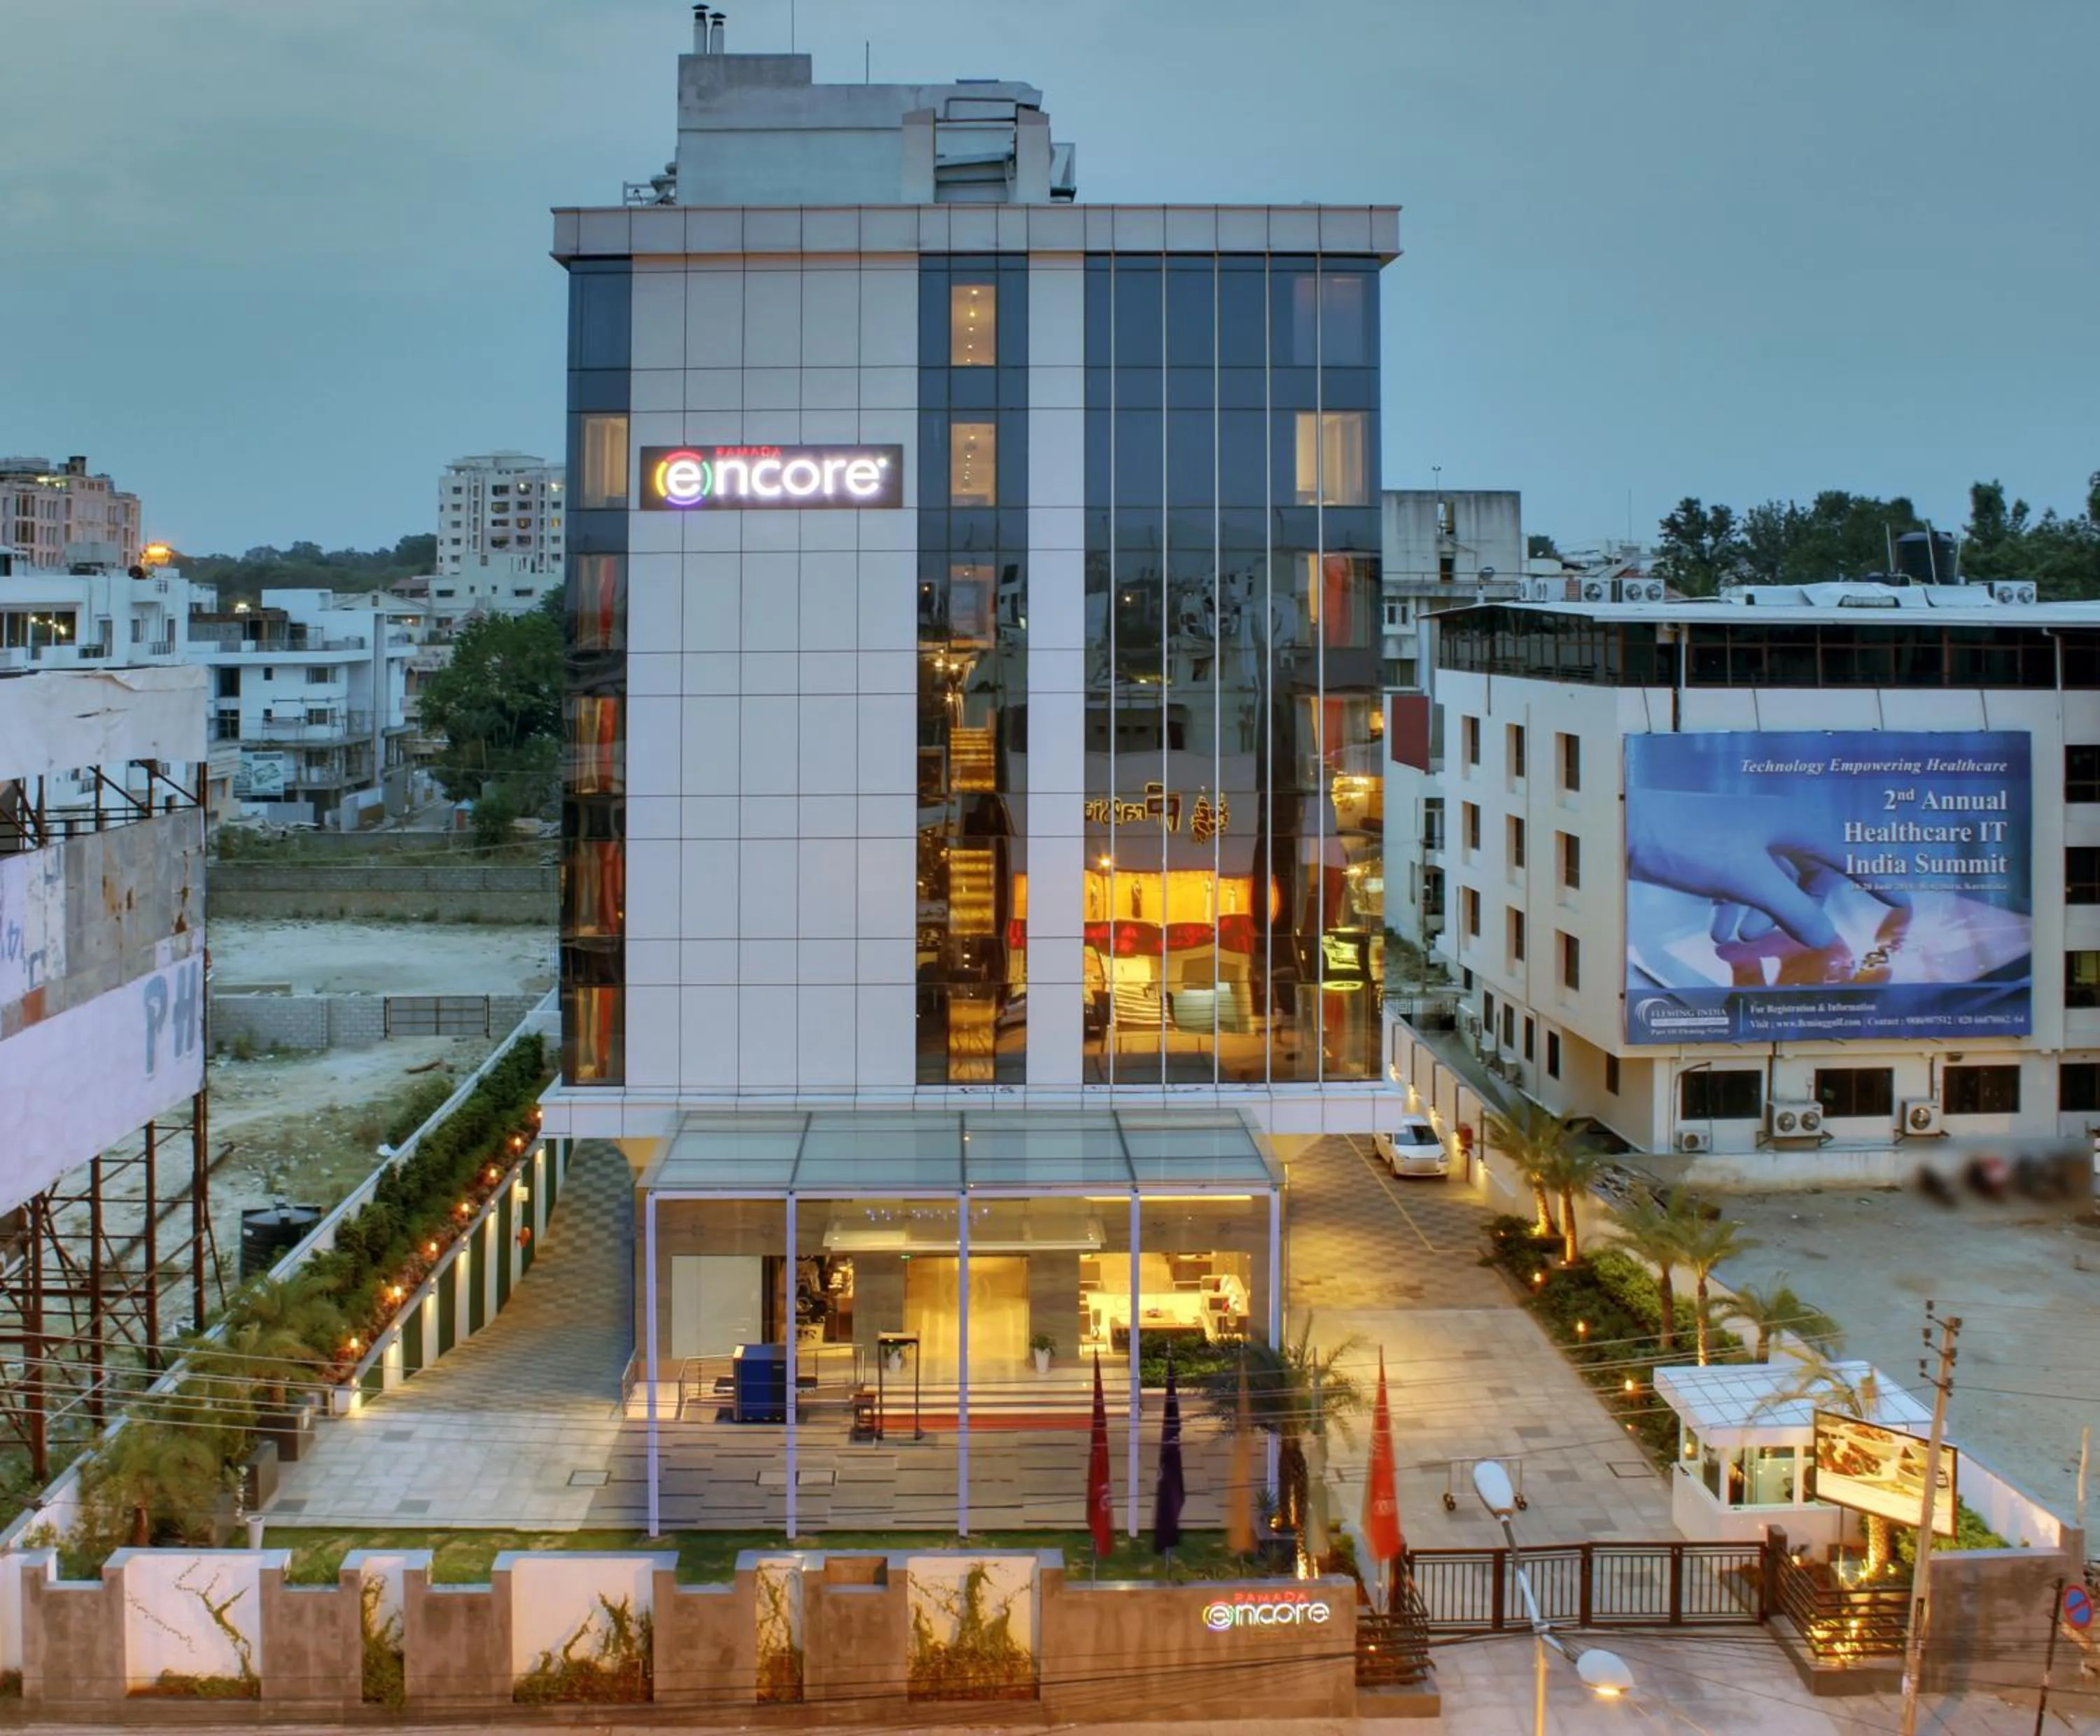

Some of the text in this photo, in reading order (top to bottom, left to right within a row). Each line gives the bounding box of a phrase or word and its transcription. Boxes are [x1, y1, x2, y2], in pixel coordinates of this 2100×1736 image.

[715, 447, 783, 457] RAMADA
[664, 457, 881, 498] encore
[1742, 757, 2008, 775] Technology Empowering Healthcare
[1882, 788, 2008, 811] 2nd Annual
[1843, 820, 2008, 843] Healthcare IT
[1845, 851, 2008, 874] India Summit
[1234, 1591, 1309, 1604] RAMADA
[1207, 1602, 1330, 1626] encore
